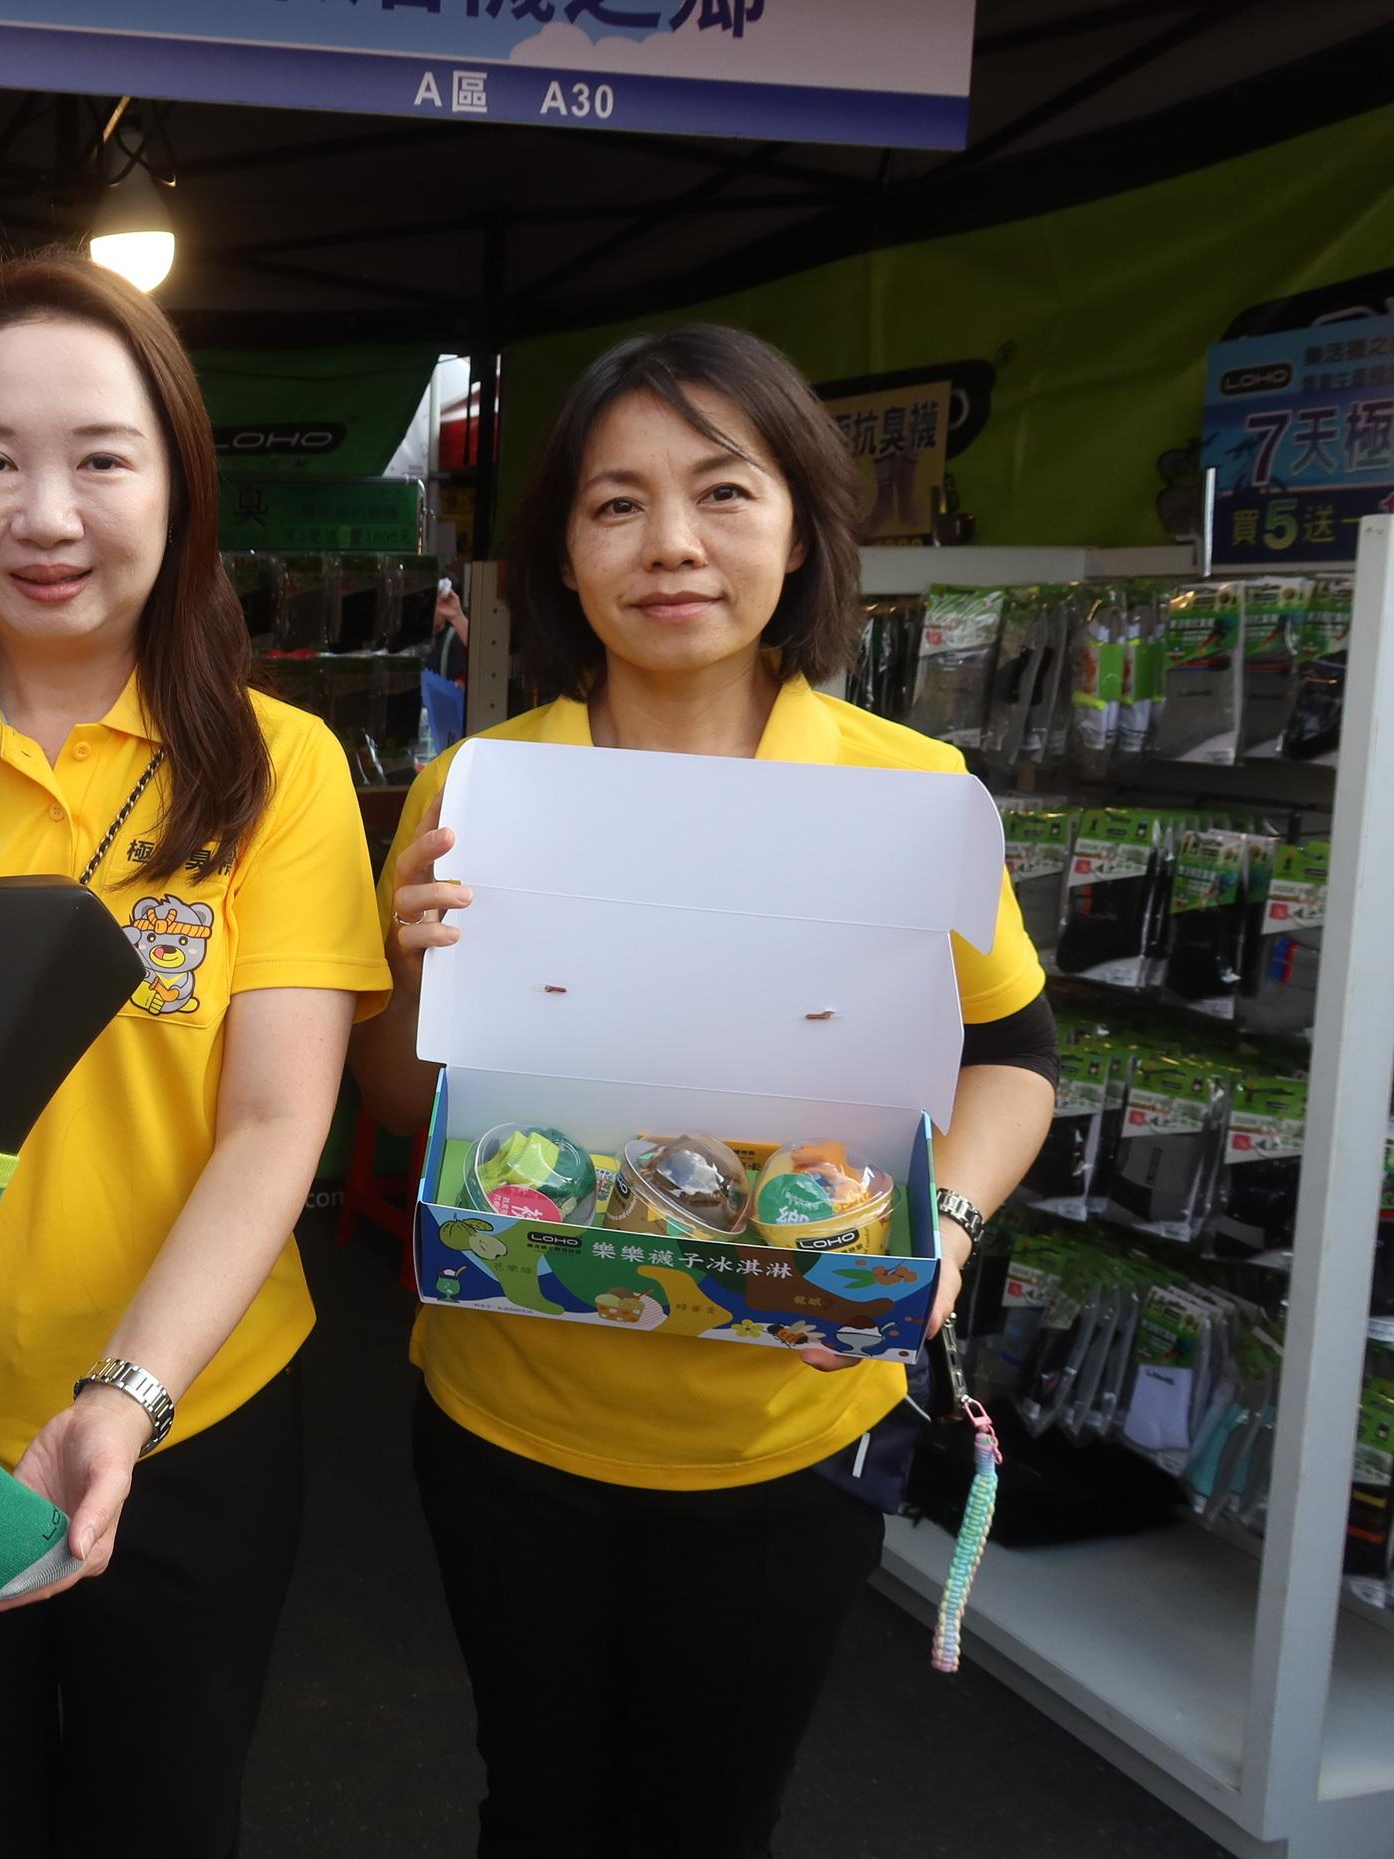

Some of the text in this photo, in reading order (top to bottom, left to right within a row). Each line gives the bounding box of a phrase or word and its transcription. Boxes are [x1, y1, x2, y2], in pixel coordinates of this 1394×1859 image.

[540, 81, 614, 119] A30
[1225, 368, 1289, 389] LOHO
[531, 1233, 578, 1246] LOHO
[799, 1231, 856, 1250] LOHO
[592, 1242, 793, 1279] 樂樂襪子冰淇淋
